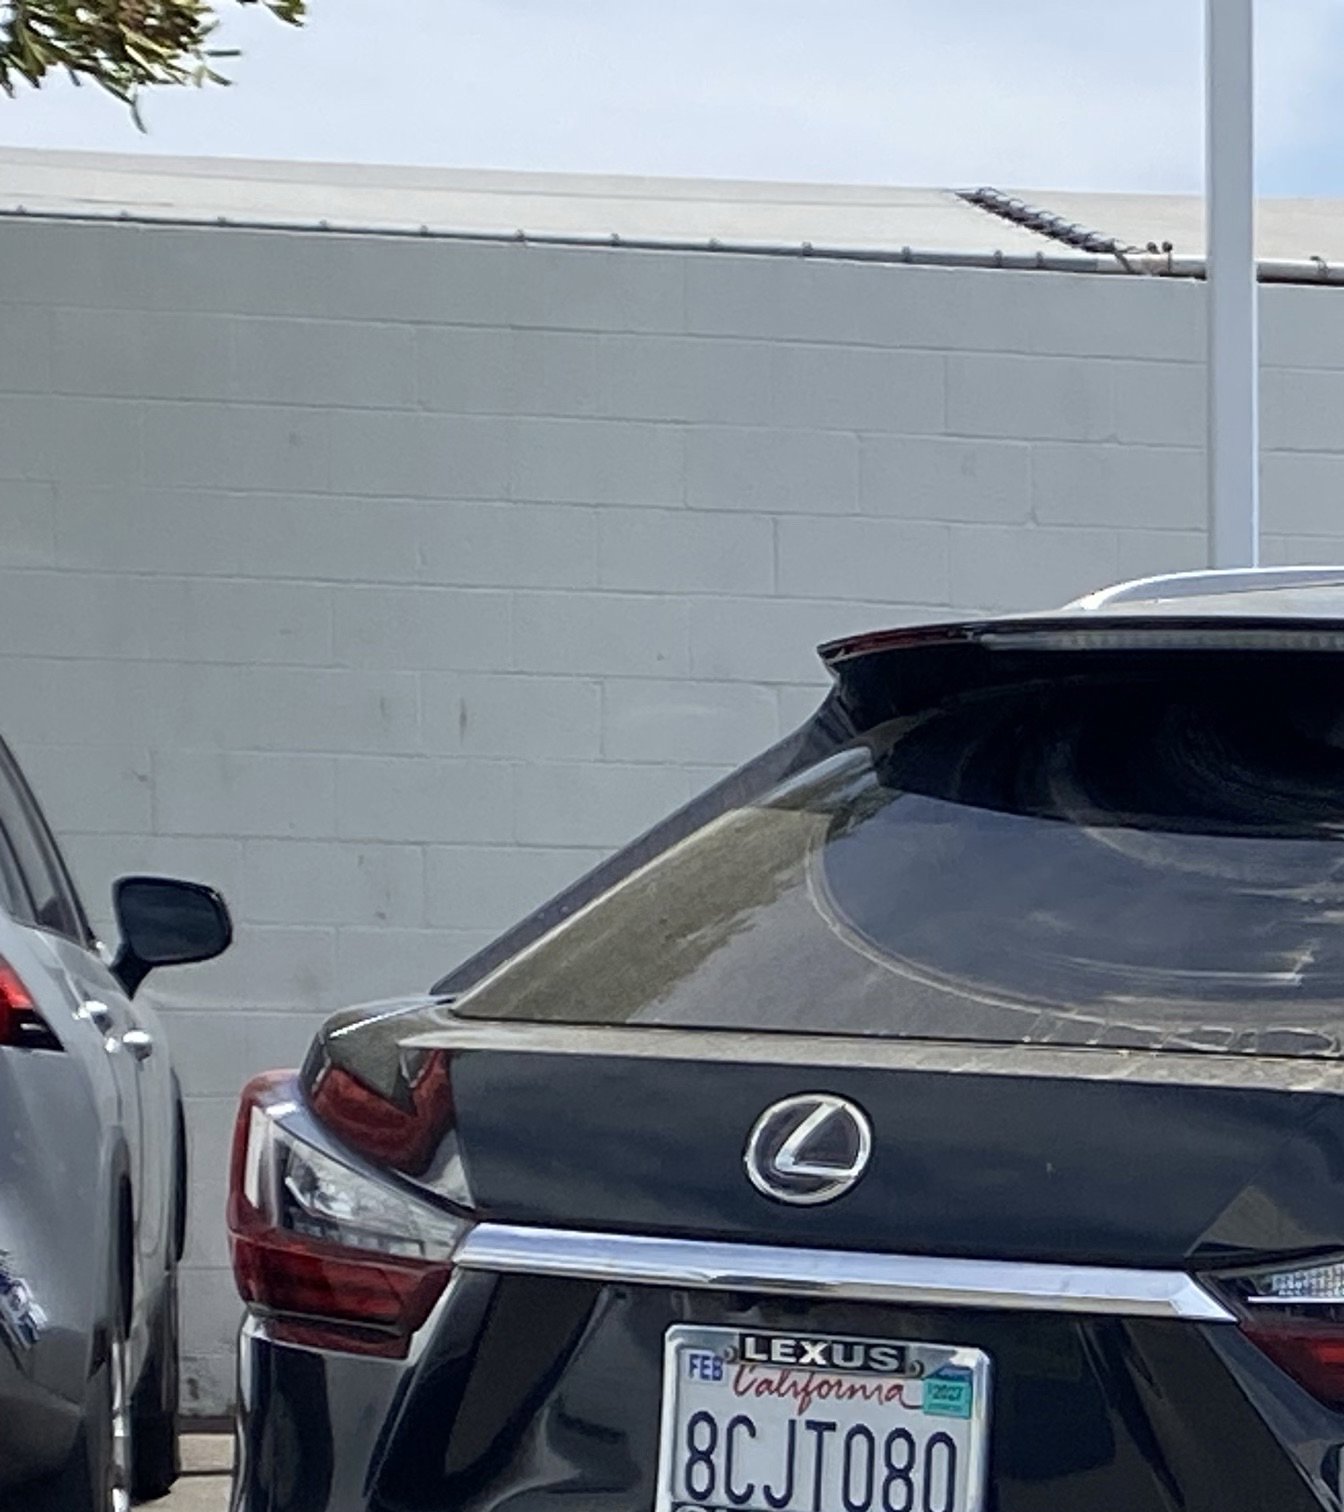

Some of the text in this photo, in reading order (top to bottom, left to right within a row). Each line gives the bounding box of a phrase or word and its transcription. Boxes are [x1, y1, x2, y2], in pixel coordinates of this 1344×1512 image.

[688, 1353, 724, 1381] FEB
[744, 1336, 901, 1372] LEXUS
[732, 1364, 923, 1415] California
